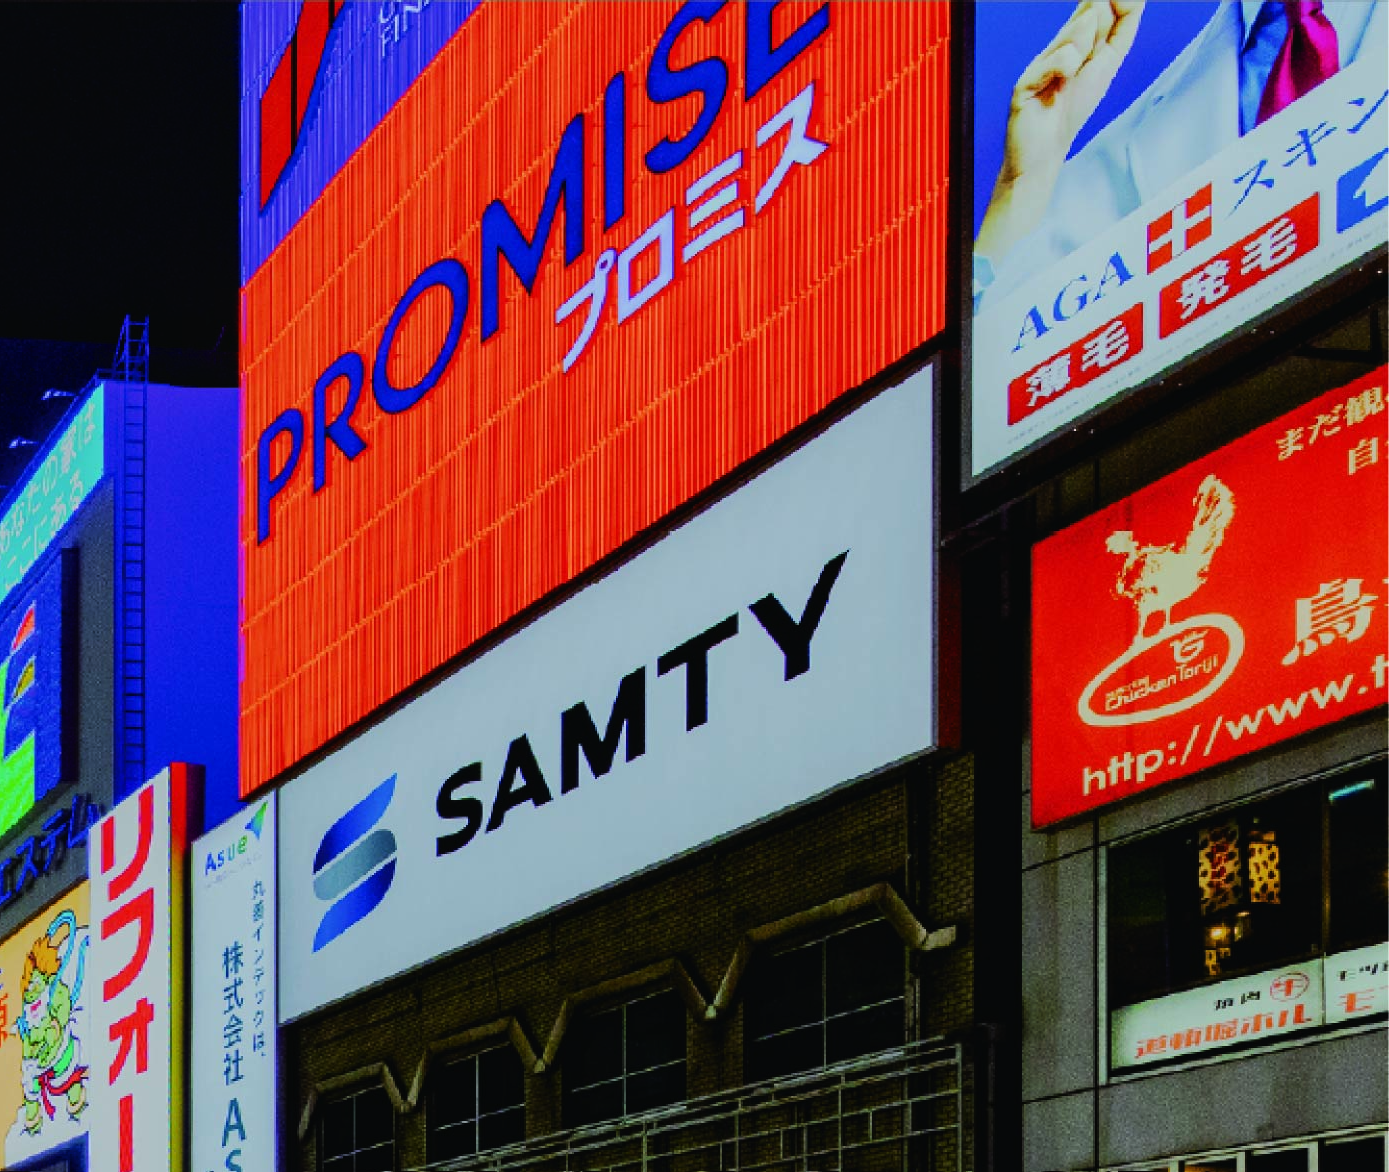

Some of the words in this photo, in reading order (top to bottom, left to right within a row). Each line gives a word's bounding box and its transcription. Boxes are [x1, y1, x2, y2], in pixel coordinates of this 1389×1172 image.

[257, 0, 830, 546] PROMISE
[554, 82, 830, 374] プロミス
[1011, 251, 1134, 355] AGA
[1226, 87, 1389, 219] スキン
[1177, 216, 1298, 321] 発毛
[1026, 319, 1130, 408] 薄毛
[435, 548, 851, 858] SAMTY
[222, 941, 244, 1086] 株式会社
